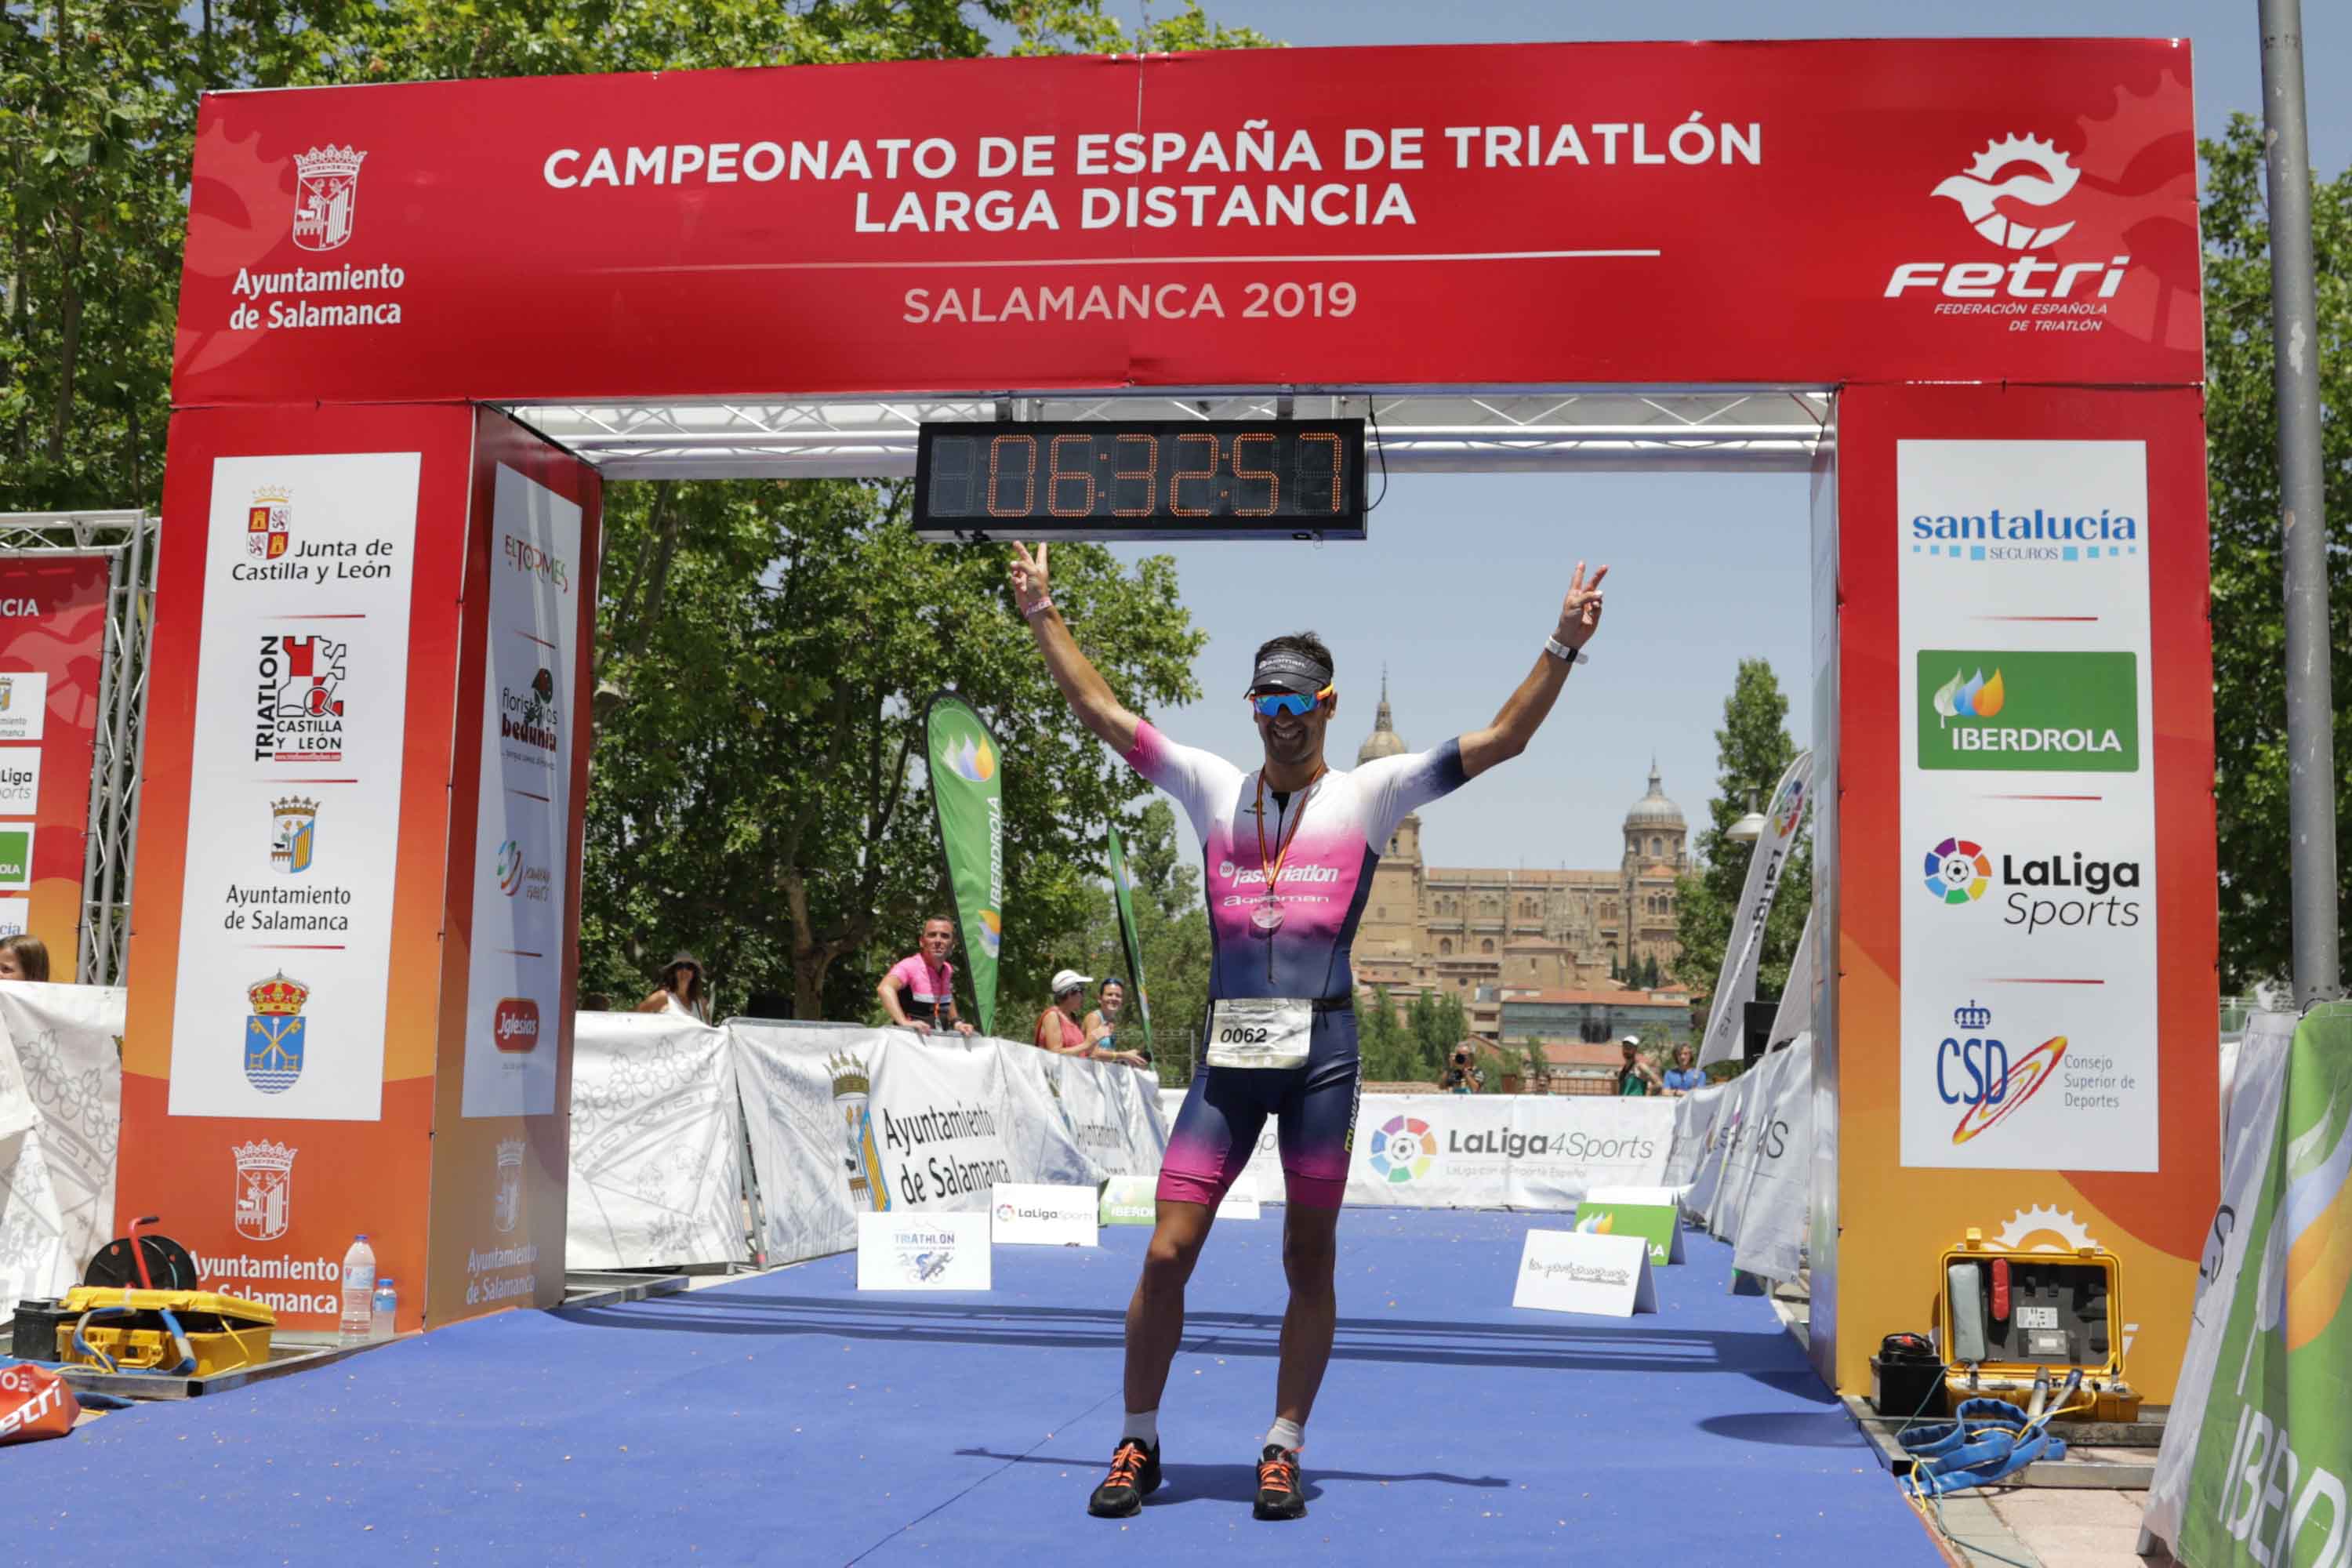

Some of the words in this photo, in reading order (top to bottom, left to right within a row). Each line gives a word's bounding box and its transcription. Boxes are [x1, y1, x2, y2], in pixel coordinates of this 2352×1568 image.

[543, 137, 956, 189] CAMPEONATO
[979, 133, 1056, 178] DE
[1076, 119, 1323, 176] ESPAÑA
[1344, 127, 1425, 171] DE
[1444, 110, 1762, 169] TRIATLÓN
[854, 189, 1060, 233] LARGA
[1081, 183, 1416, 229] DISTANCIA
[231, 263, 405, 302] Ayuntamiento
[229, 302, 260, 331] de
[268, 298, 401, 328] Salamanca
[902, 283, 1225, 324] SALAMANCA
[1243, 281, 1358, 319] 2019
[1934, 301, 2027, 314] FEDERACIÓN
[2032, 301, 2108, 314] ESPAÑOLA
[2009, 320, 2028, 332] DE
[2034, 319, 2103, 332] TRIATLÓN
[986, 432, 1342, 517] 06:32:57
[1912, 509, 2136, 540] santalucía
[294, 539, 358, 558] Junta
[365, 539, 394, 557] de
[1990, 546, 2059, 561] SEGUROS
[232, 561, 308, 582] Castilla
[315, 566, 329, 583] y
[336, 560, 391, 579] León
[0, 597, 39, 617] CIA
[255, 636, 278, 761] TRIATLON
[277, 720, 343, 732] CASTILLA
[276, 738, 285, 749] Y
[299, 734, 342, 750] LEÓN
[1952, 727, 2122, 753] IBERDROLA
[0, 767, 33, 786] Liga
[0, 786, 32, 800] orts
[985, 796, 1002, 909] IBERDROLA
[2002, 851, 2140, 895] LaLiga
[226, 884, 351, 907] Ayuntamiento
[224, 909, 245, 930] de
[252, 909, 349, 931] Salamanca
[2004, 892, 2140, 935] Sports
[1220, 1027, 1268, 1044] 0062
[1936, 1037, 2008, 1105] CSD
[2063, 1054, 2113, 1072] Consejo
[2063, 1073, 2116, 1092] Superior
[2120, 1075, 2135, 1090] de
[2063, 1093, 2119, 1110] Deportes
[884, 1099, 996, 1156] Ayuntamiento
[1448, 1127, 1654, 1162] LaLiga4Sports
[900, 1163, 927, 1205] de
[929, 1156, 1011, 1199] Salamanca
